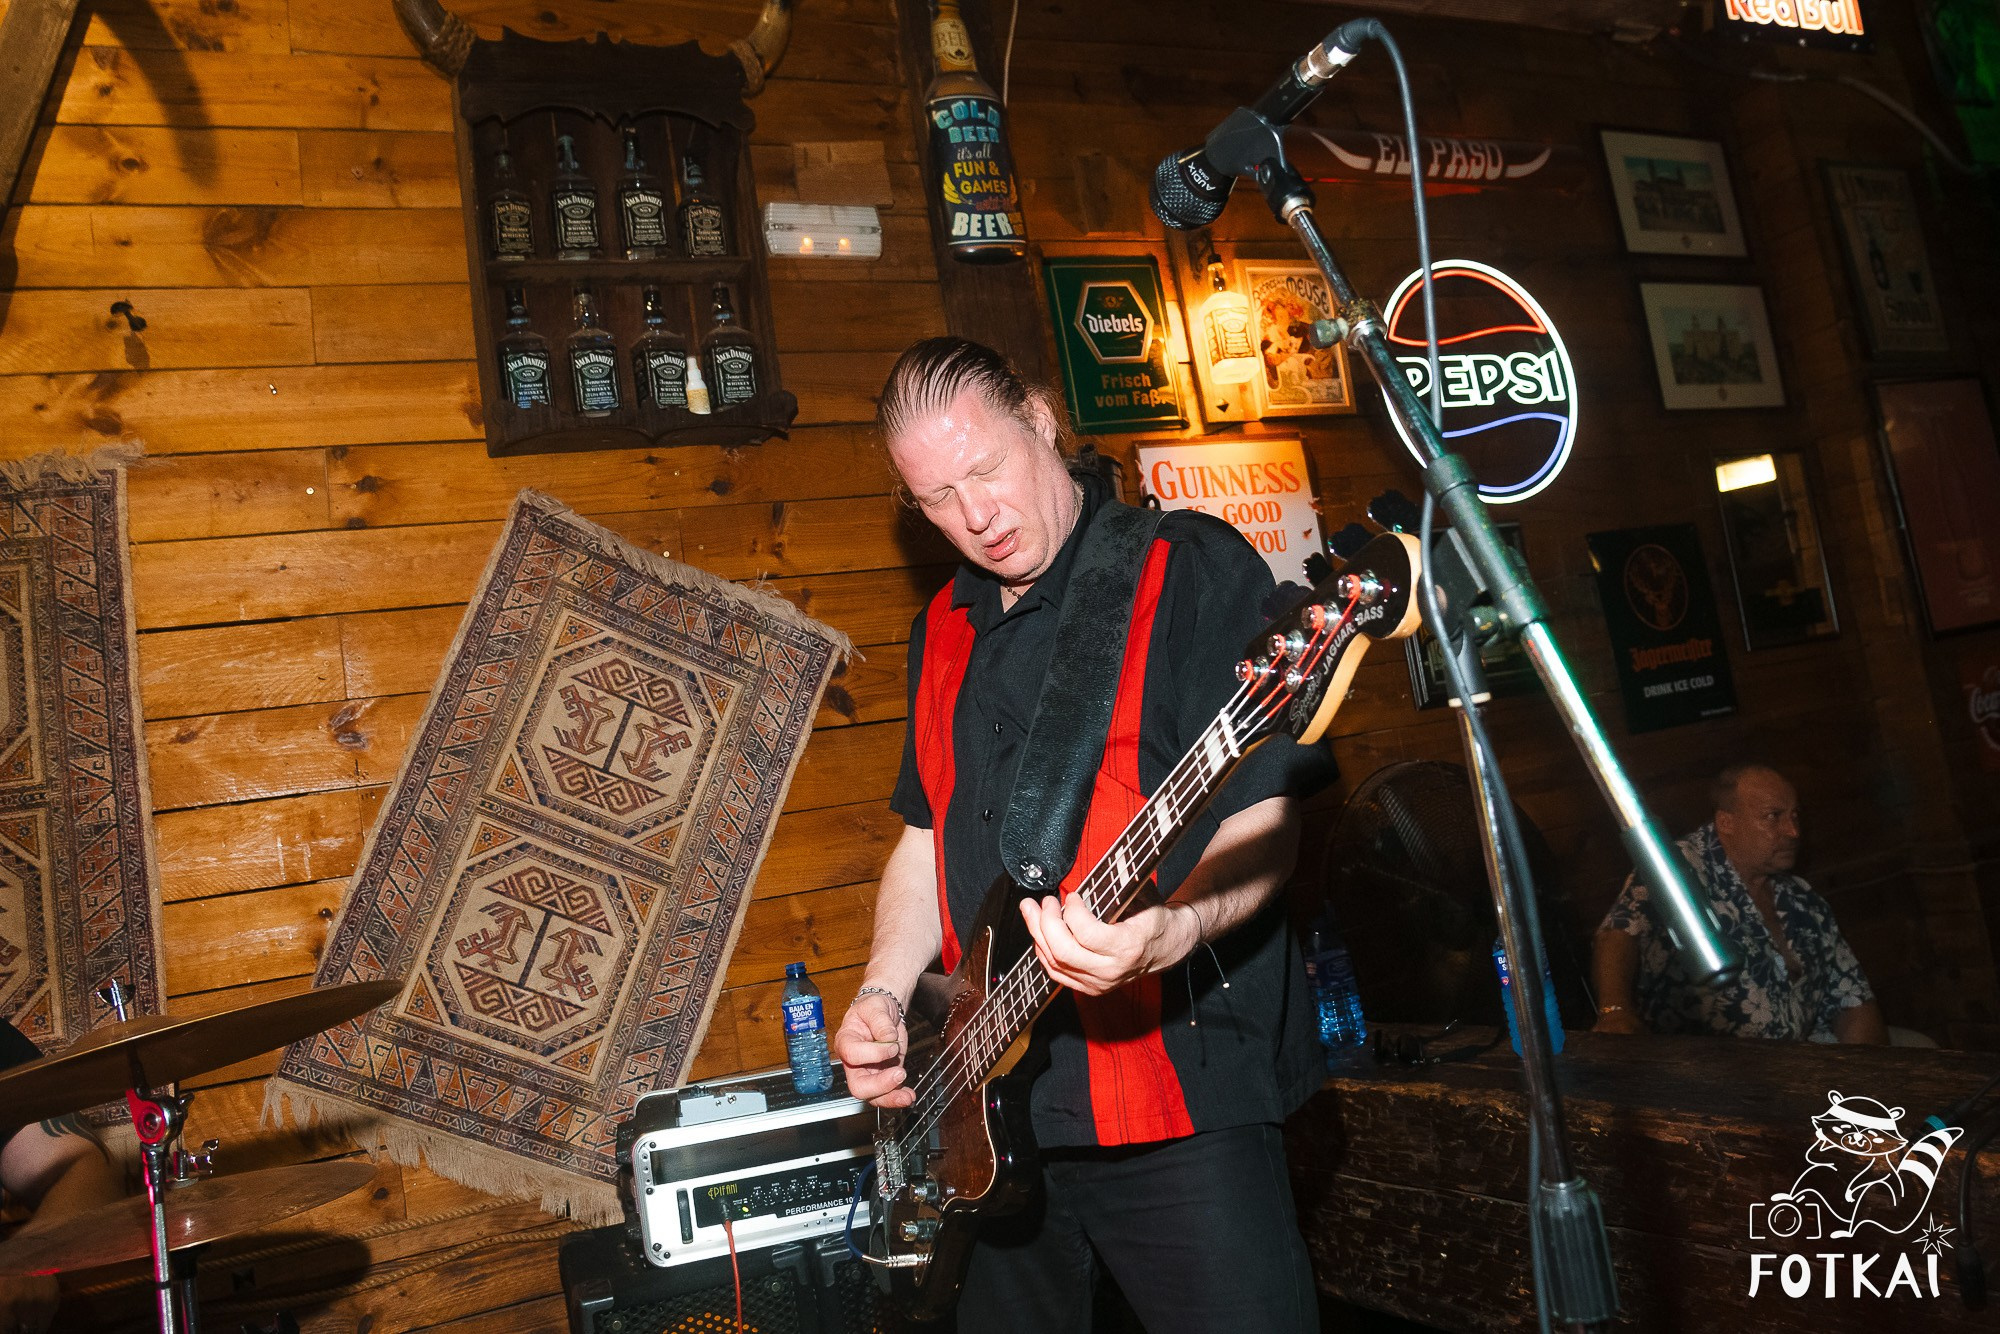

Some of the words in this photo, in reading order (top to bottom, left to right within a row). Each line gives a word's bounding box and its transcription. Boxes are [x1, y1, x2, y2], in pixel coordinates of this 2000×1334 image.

[976, 143, 991, 159] all
[1424, 136, 1503, 181] PASO
[953, 161, 986, 178] FUN
[988, 161, 1001, 176] &
[1188, 161, 1216, 191] AUDIX
[960, 180, 1008, 195] GAMES
[951, 211, 1013, 238] BEER
[507, 359, 523, 372] JACK
[575, 356, 590, 370] JACK
[650, 356, 664, 369] JACK
[716, 351, 731, 364] JACK
[1101, 373, 1152, 390] Frisch
[1396, 351, 1567, 407] PEPSI
[1094, 394, 1129, 408] vom
[1151, 460, 1300, 500] GUINNESS
[1222, 501, 1282, 526] GOOD
[1243, 529, 1288, 554] YOU
[1322, 622, 1357, 675] JAGUAR
[1356, 605, 1384, 626] BASS
[1643, 682, 1673, 698] DRINK
[1674, 679, 1690, 693] ICE
[1690, 675, 1715, 690] COLD
[789, 1004, 804, 1014] BAJA
[805, 1002, 814, 1010] EN
[785, 1198, 844, 1216] PERFORMANCE
